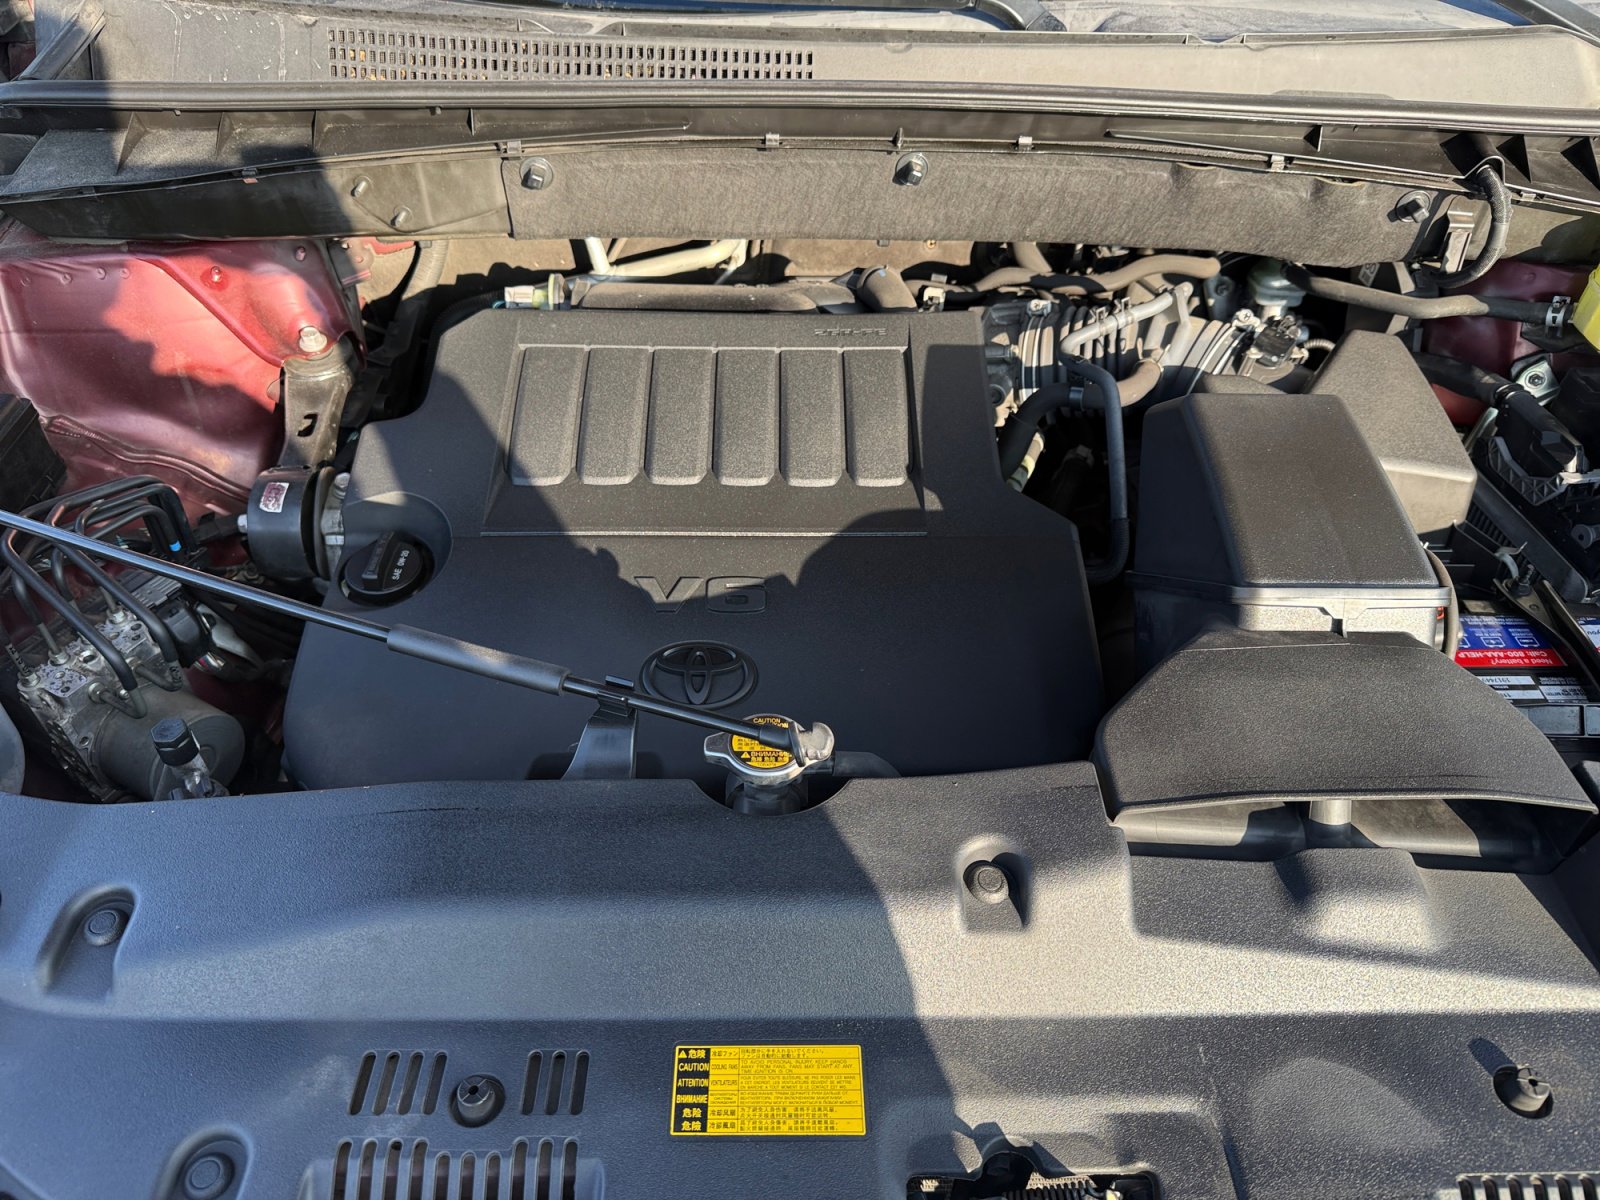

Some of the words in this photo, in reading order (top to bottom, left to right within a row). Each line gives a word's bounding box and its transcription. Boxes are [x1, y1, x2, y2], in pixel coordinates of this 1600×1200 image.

[634, 576, 767, 614] V6
[753, 717, 780, 725] CAUTION
[678, 1062, 710, 1071] CAUTION
[677, 1079, 709, 1087] ATTENTION
[676, 1095, 708, 1103] ВНИМАНИЕ
